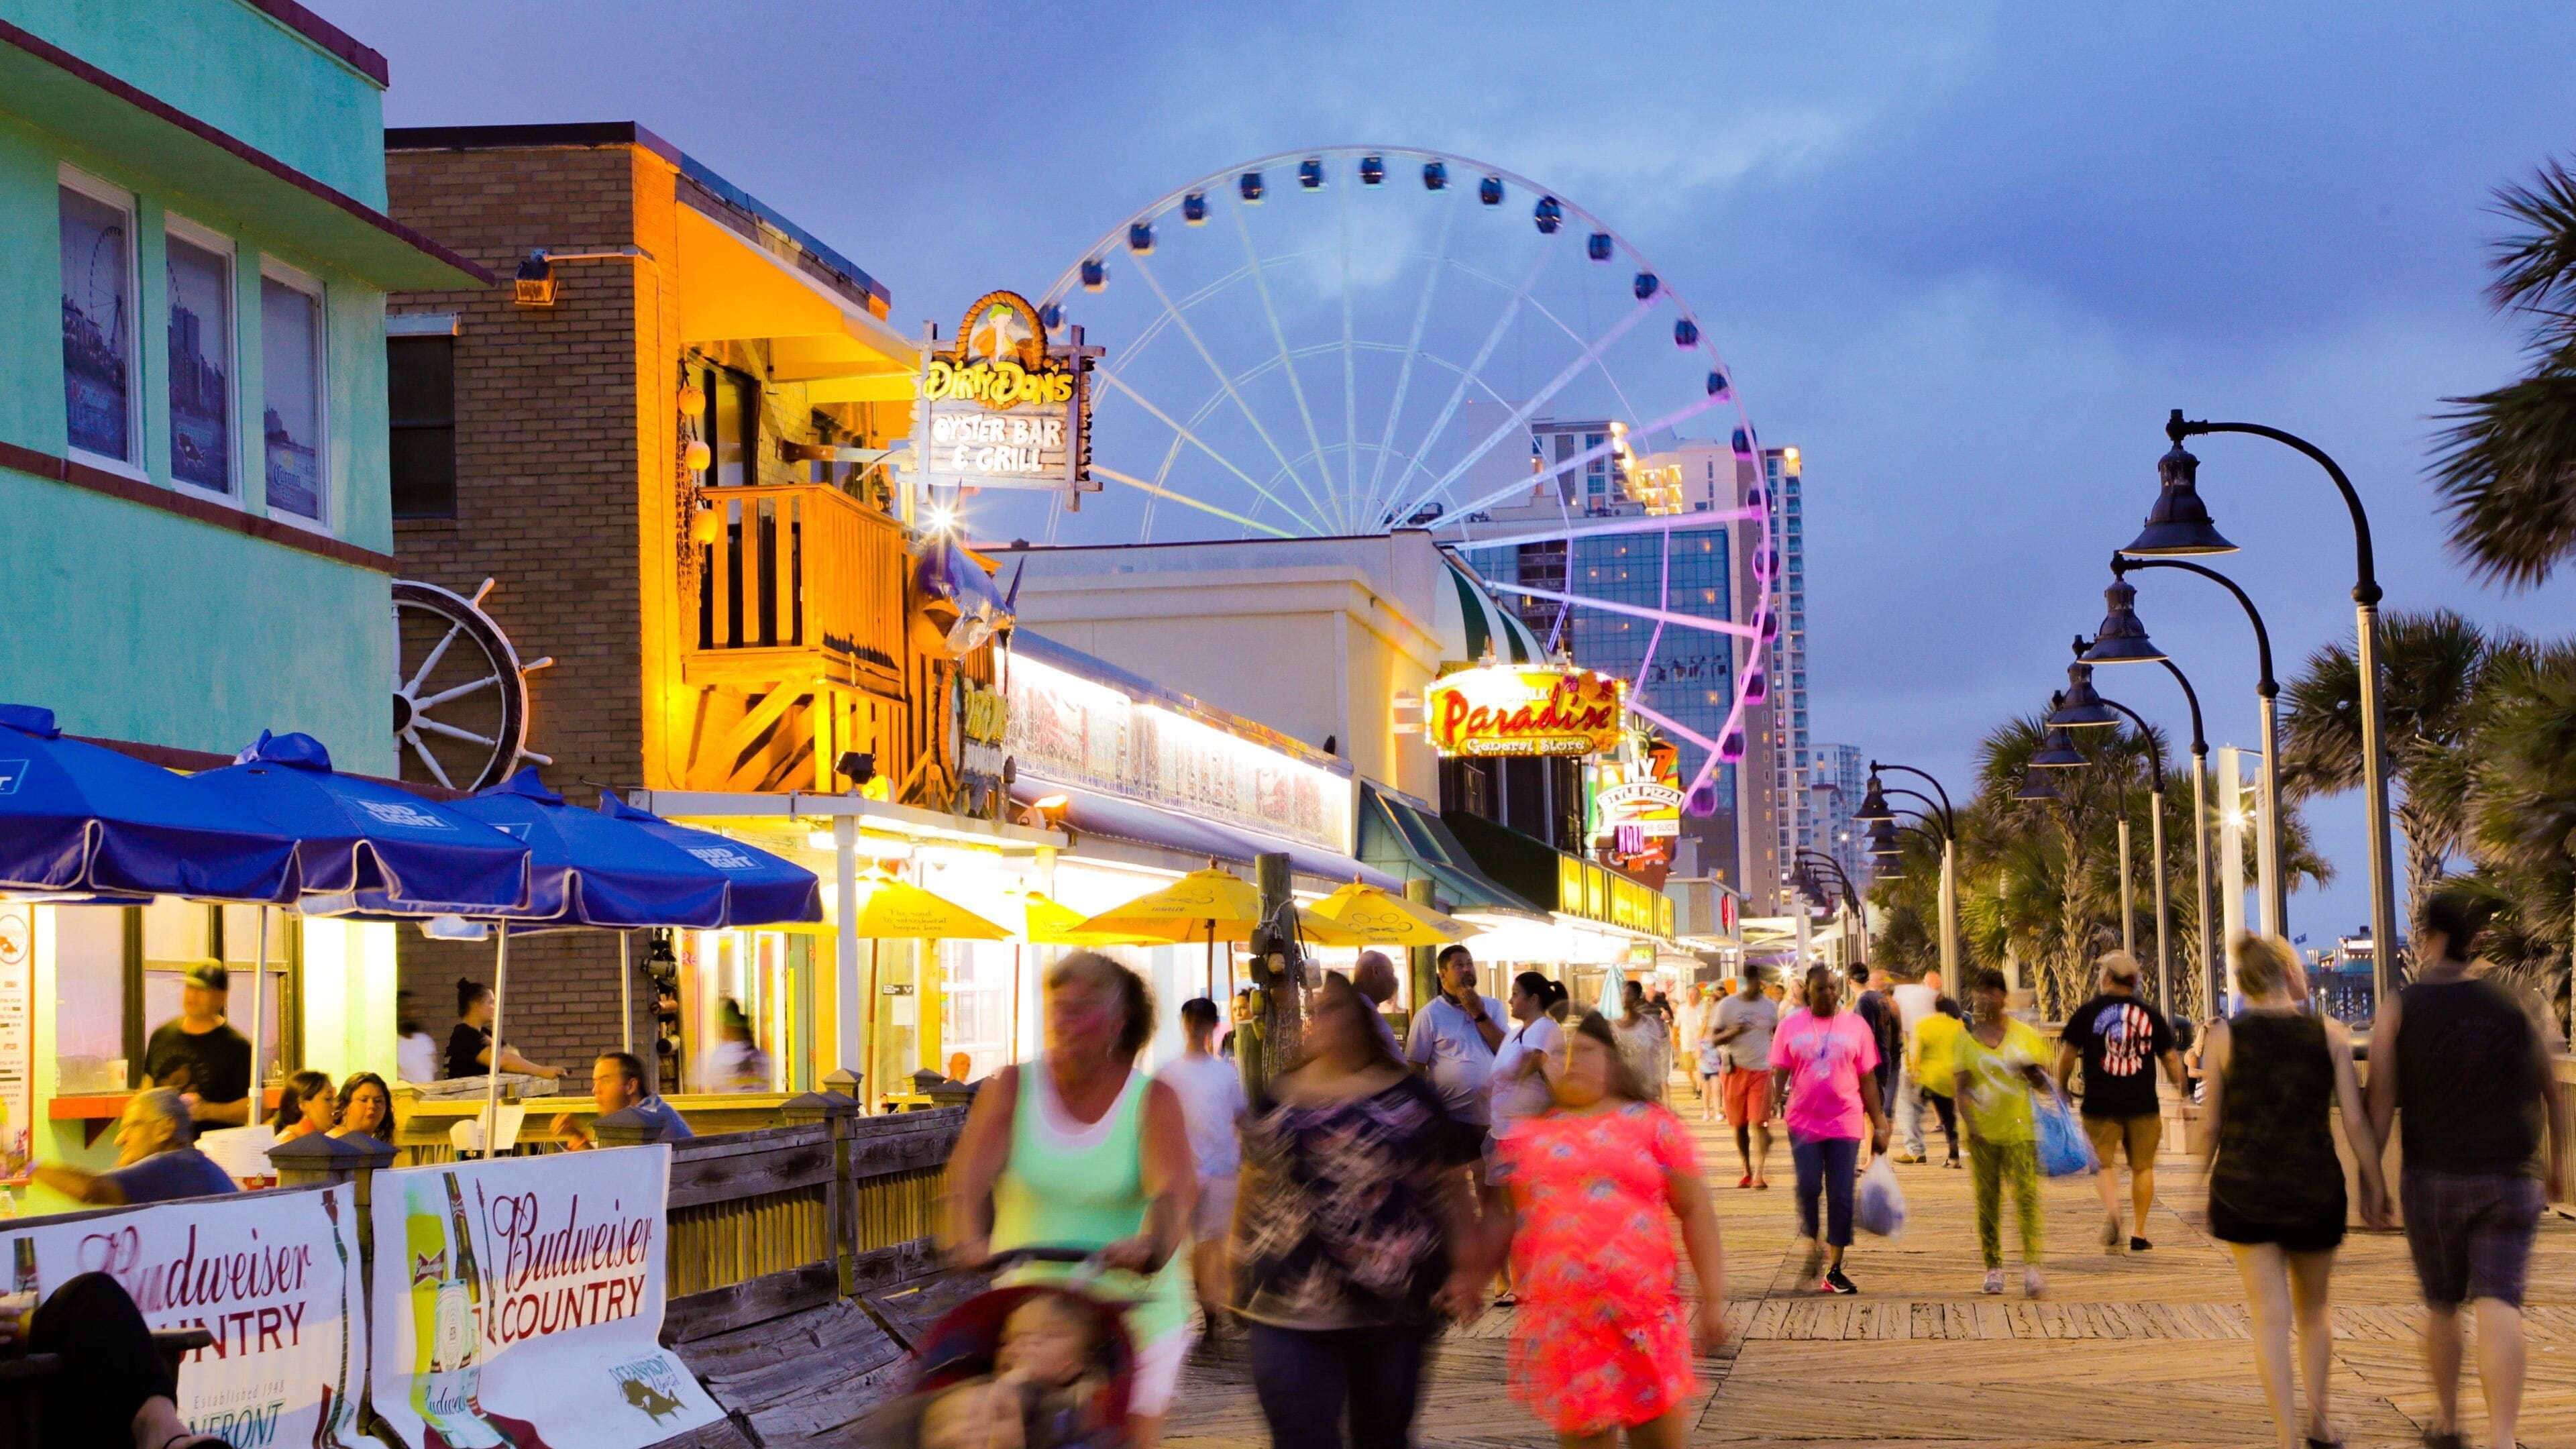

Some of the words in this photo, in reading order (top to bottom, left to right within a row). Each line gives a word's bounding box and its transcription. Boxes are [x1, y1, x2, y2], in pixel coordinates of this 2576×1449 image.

[932, 413, 1006, 443] OYSTER
[1013, 418, 1061, 447] BAR
[951, 444, 970, 471] &
[975, 446, 1043, 472] GRILL
[273, 464, 301, 488] Corona
[1443, 682, 1612, 745] Paradise
[1467, 738, 1534, 755] General
[1540, 740, 1585, 752] Store
[1601, 786, 1640, 804] STYLE
[1643, 786, 1679, 804] PIZZA
[1657, 822, 1676, 832] SLICE
[687, 848, 734, 859] BUD
[492, 1191, 653, 1294] Budweiser
[501, 1273, 645, 1343] COUNTRY
[193, 1386, 258, 1409] Established
